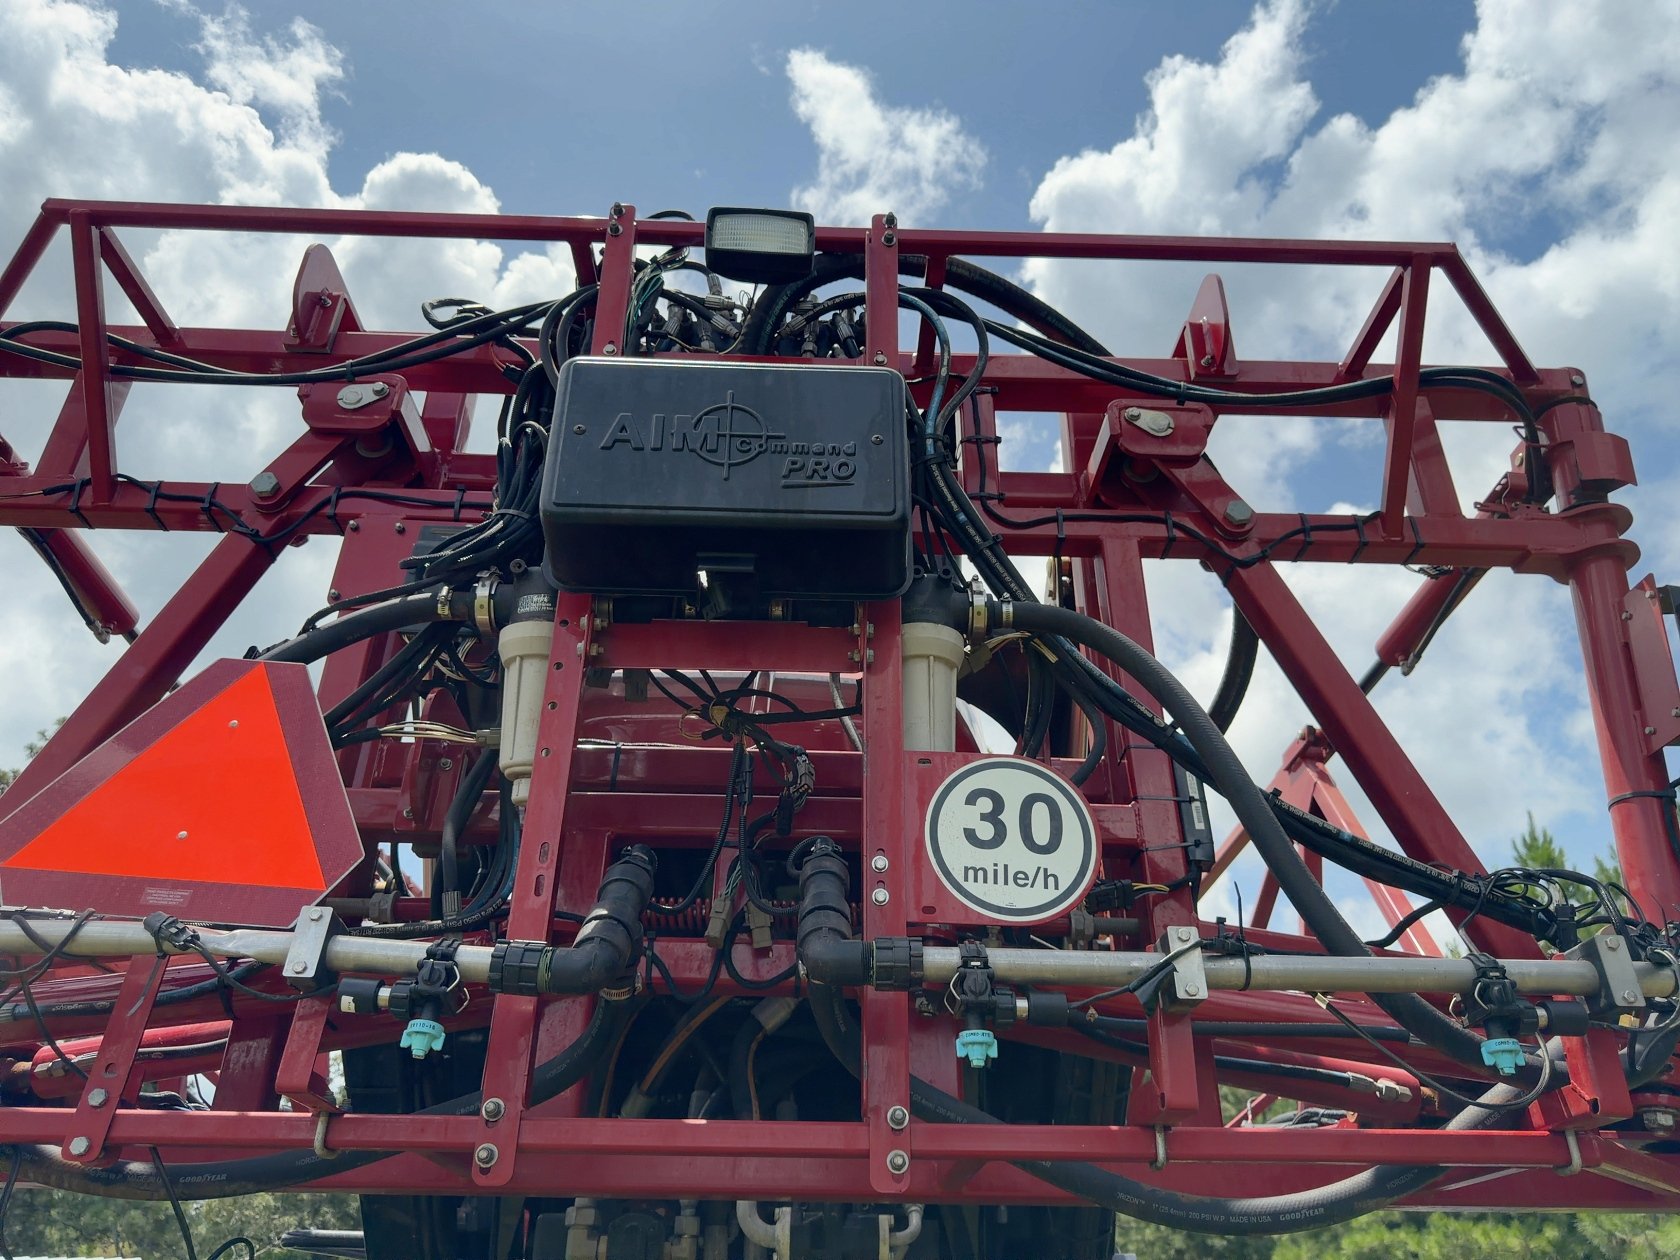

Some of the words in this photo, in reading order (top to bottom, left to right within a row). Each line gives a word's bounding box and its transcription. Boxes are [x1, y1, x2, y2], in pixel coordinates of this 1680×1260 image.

[600, 413, 720, 451] AIM
[736, 438, 857, 456] Command
[781, 458, 857, 480] PRO
[963, 788, 1063, 855] 30
[963, 863, 1060, 891] mile/h
[179, 1173, 227, 1184] GOODYEAR
[296, 1155, 321, 1167] HORIZO
[1188, 1211, 1200, 1220] 200
[1200, 1213, 1212, 1222] PSI
[1229, 1215, 1249, 1223] MADE
[1250, 1215, 1257, 1223] IN
[1257, 1215, 1272, 1223] USA
[1279, 1207, 1325, 1222] GOODYEAR
